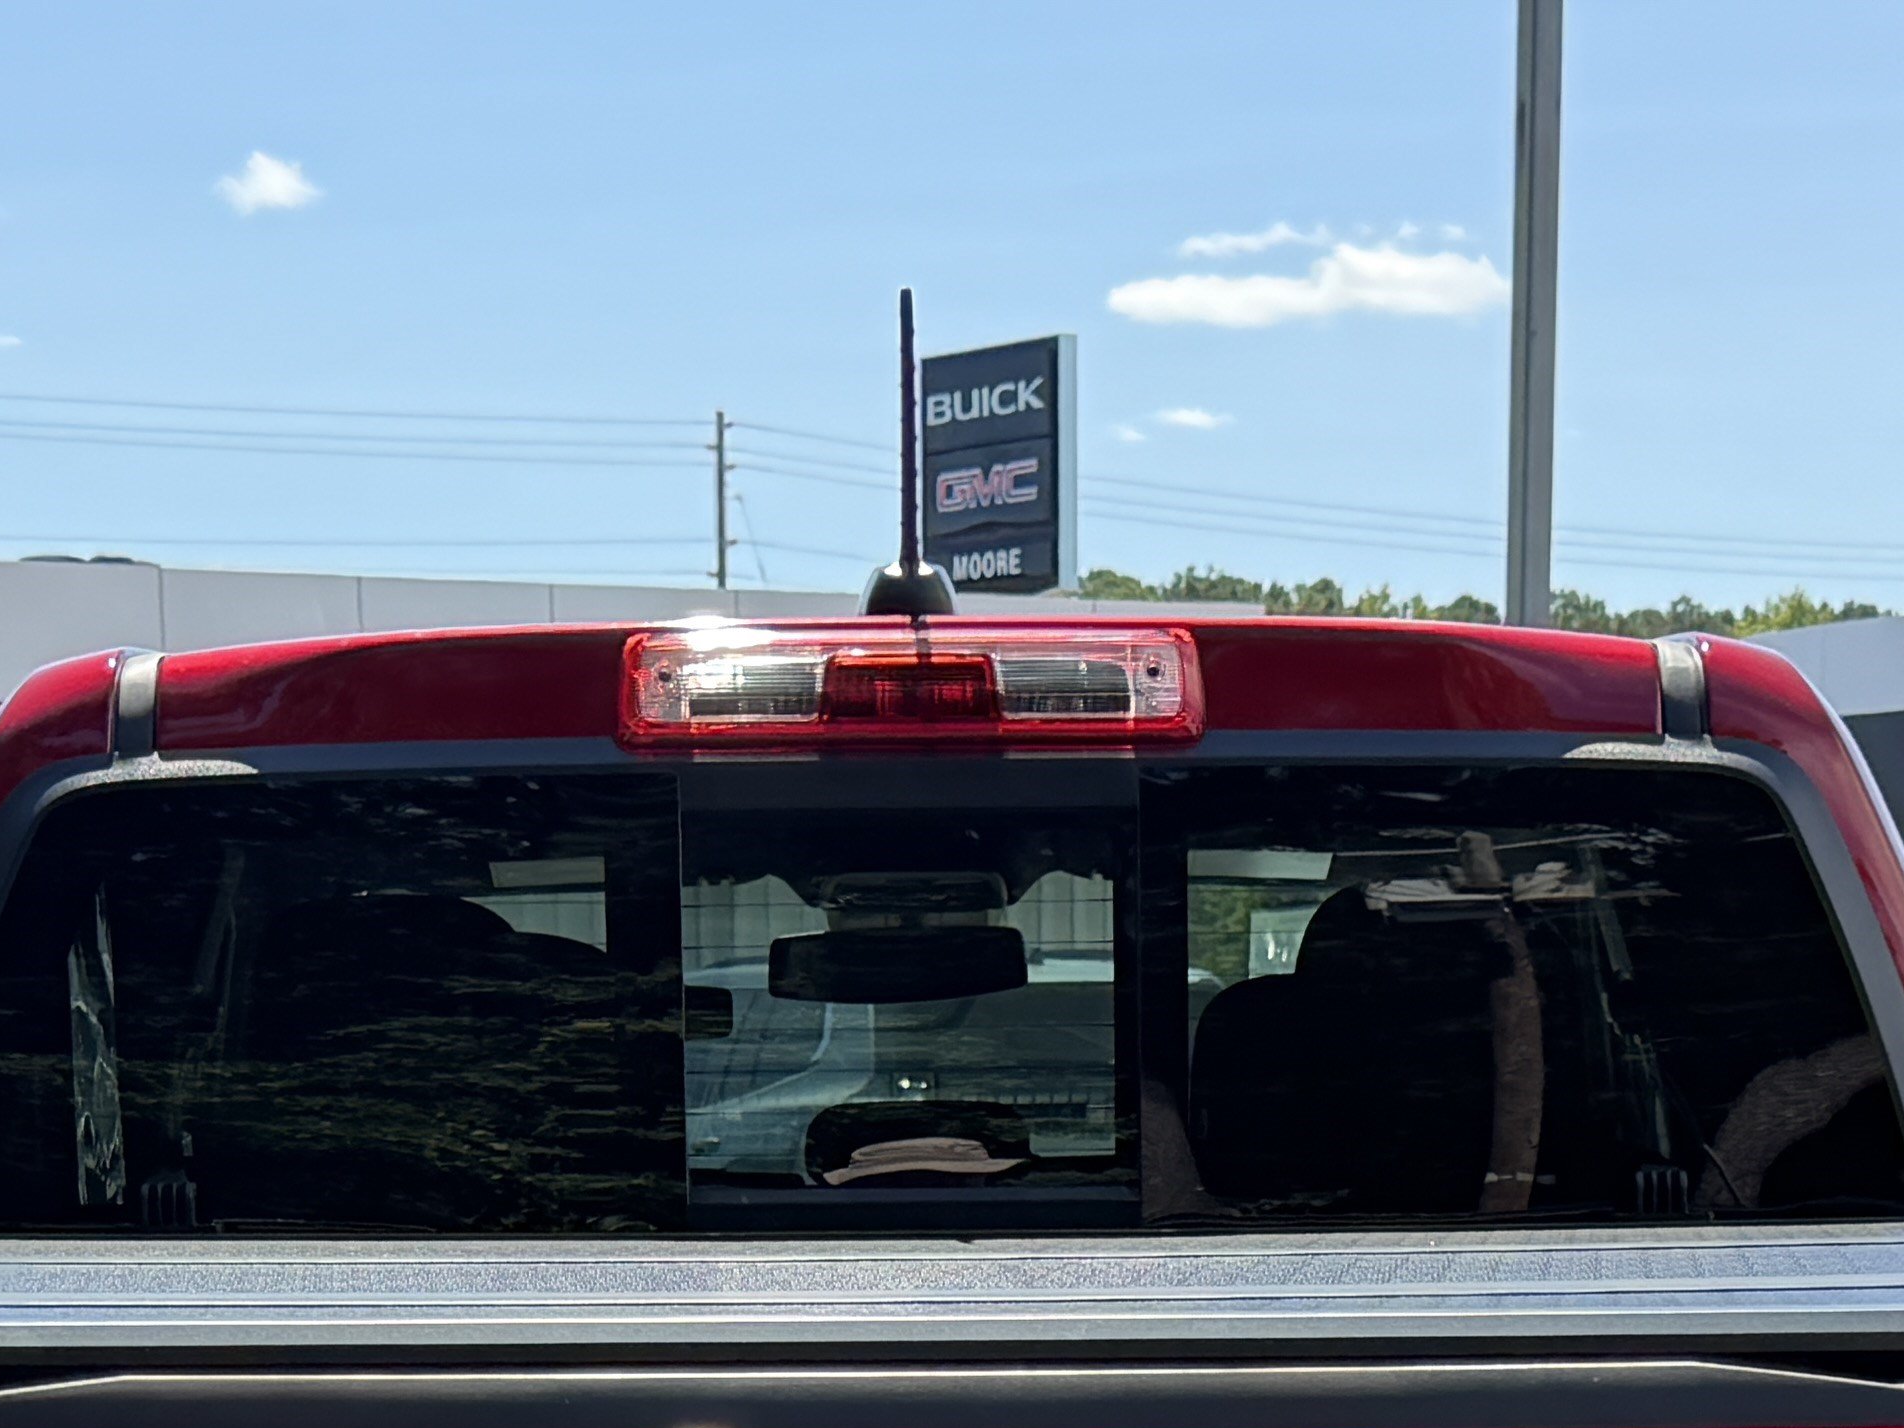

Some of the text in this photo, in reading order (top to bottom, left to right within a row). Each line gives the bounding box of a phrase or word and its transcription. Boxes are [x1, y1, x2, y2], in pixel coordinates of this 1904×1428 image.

[926, 376, 1044, 426] BUICK
[936, 458, 1039, 513] GMC
[953, 549, 1022, 582] MOORE
